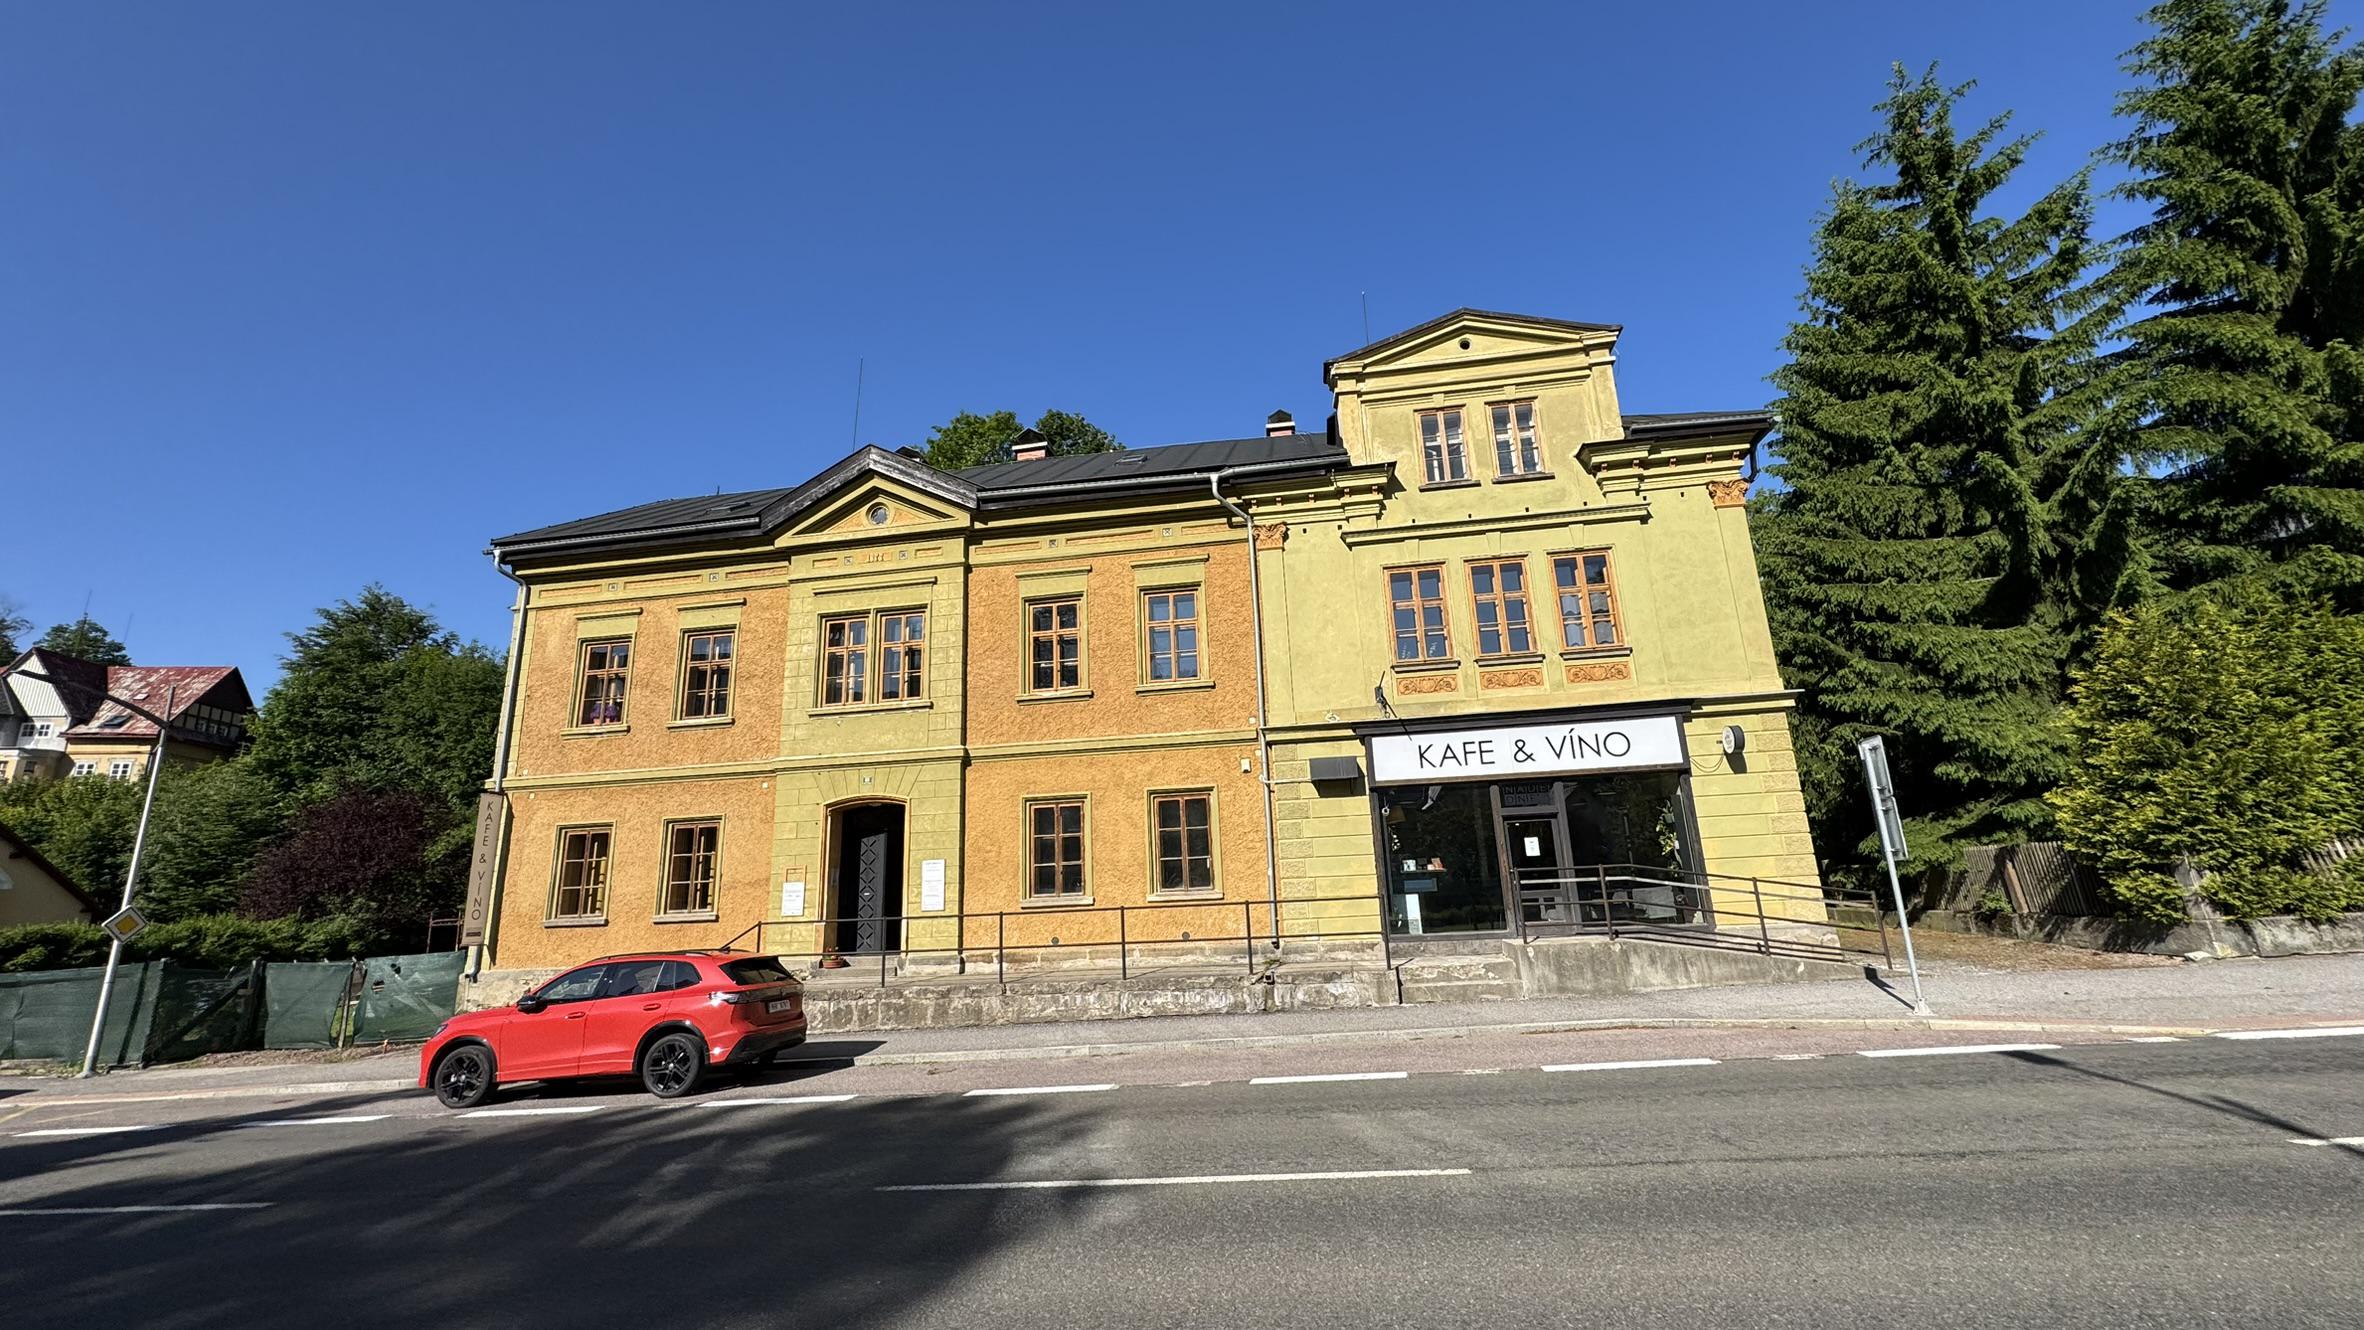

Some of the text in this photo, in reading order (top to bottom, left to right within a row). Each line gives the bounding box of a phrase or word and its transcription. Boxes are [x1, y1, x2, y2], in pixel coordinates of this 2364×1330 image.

[1418, 728, 1631, 769] KAFE & VÍNO
[482, 800, 494, 847] KAFE
[478, 853, 487, 864] &
[471, 871, 486, 921] VÍNO
